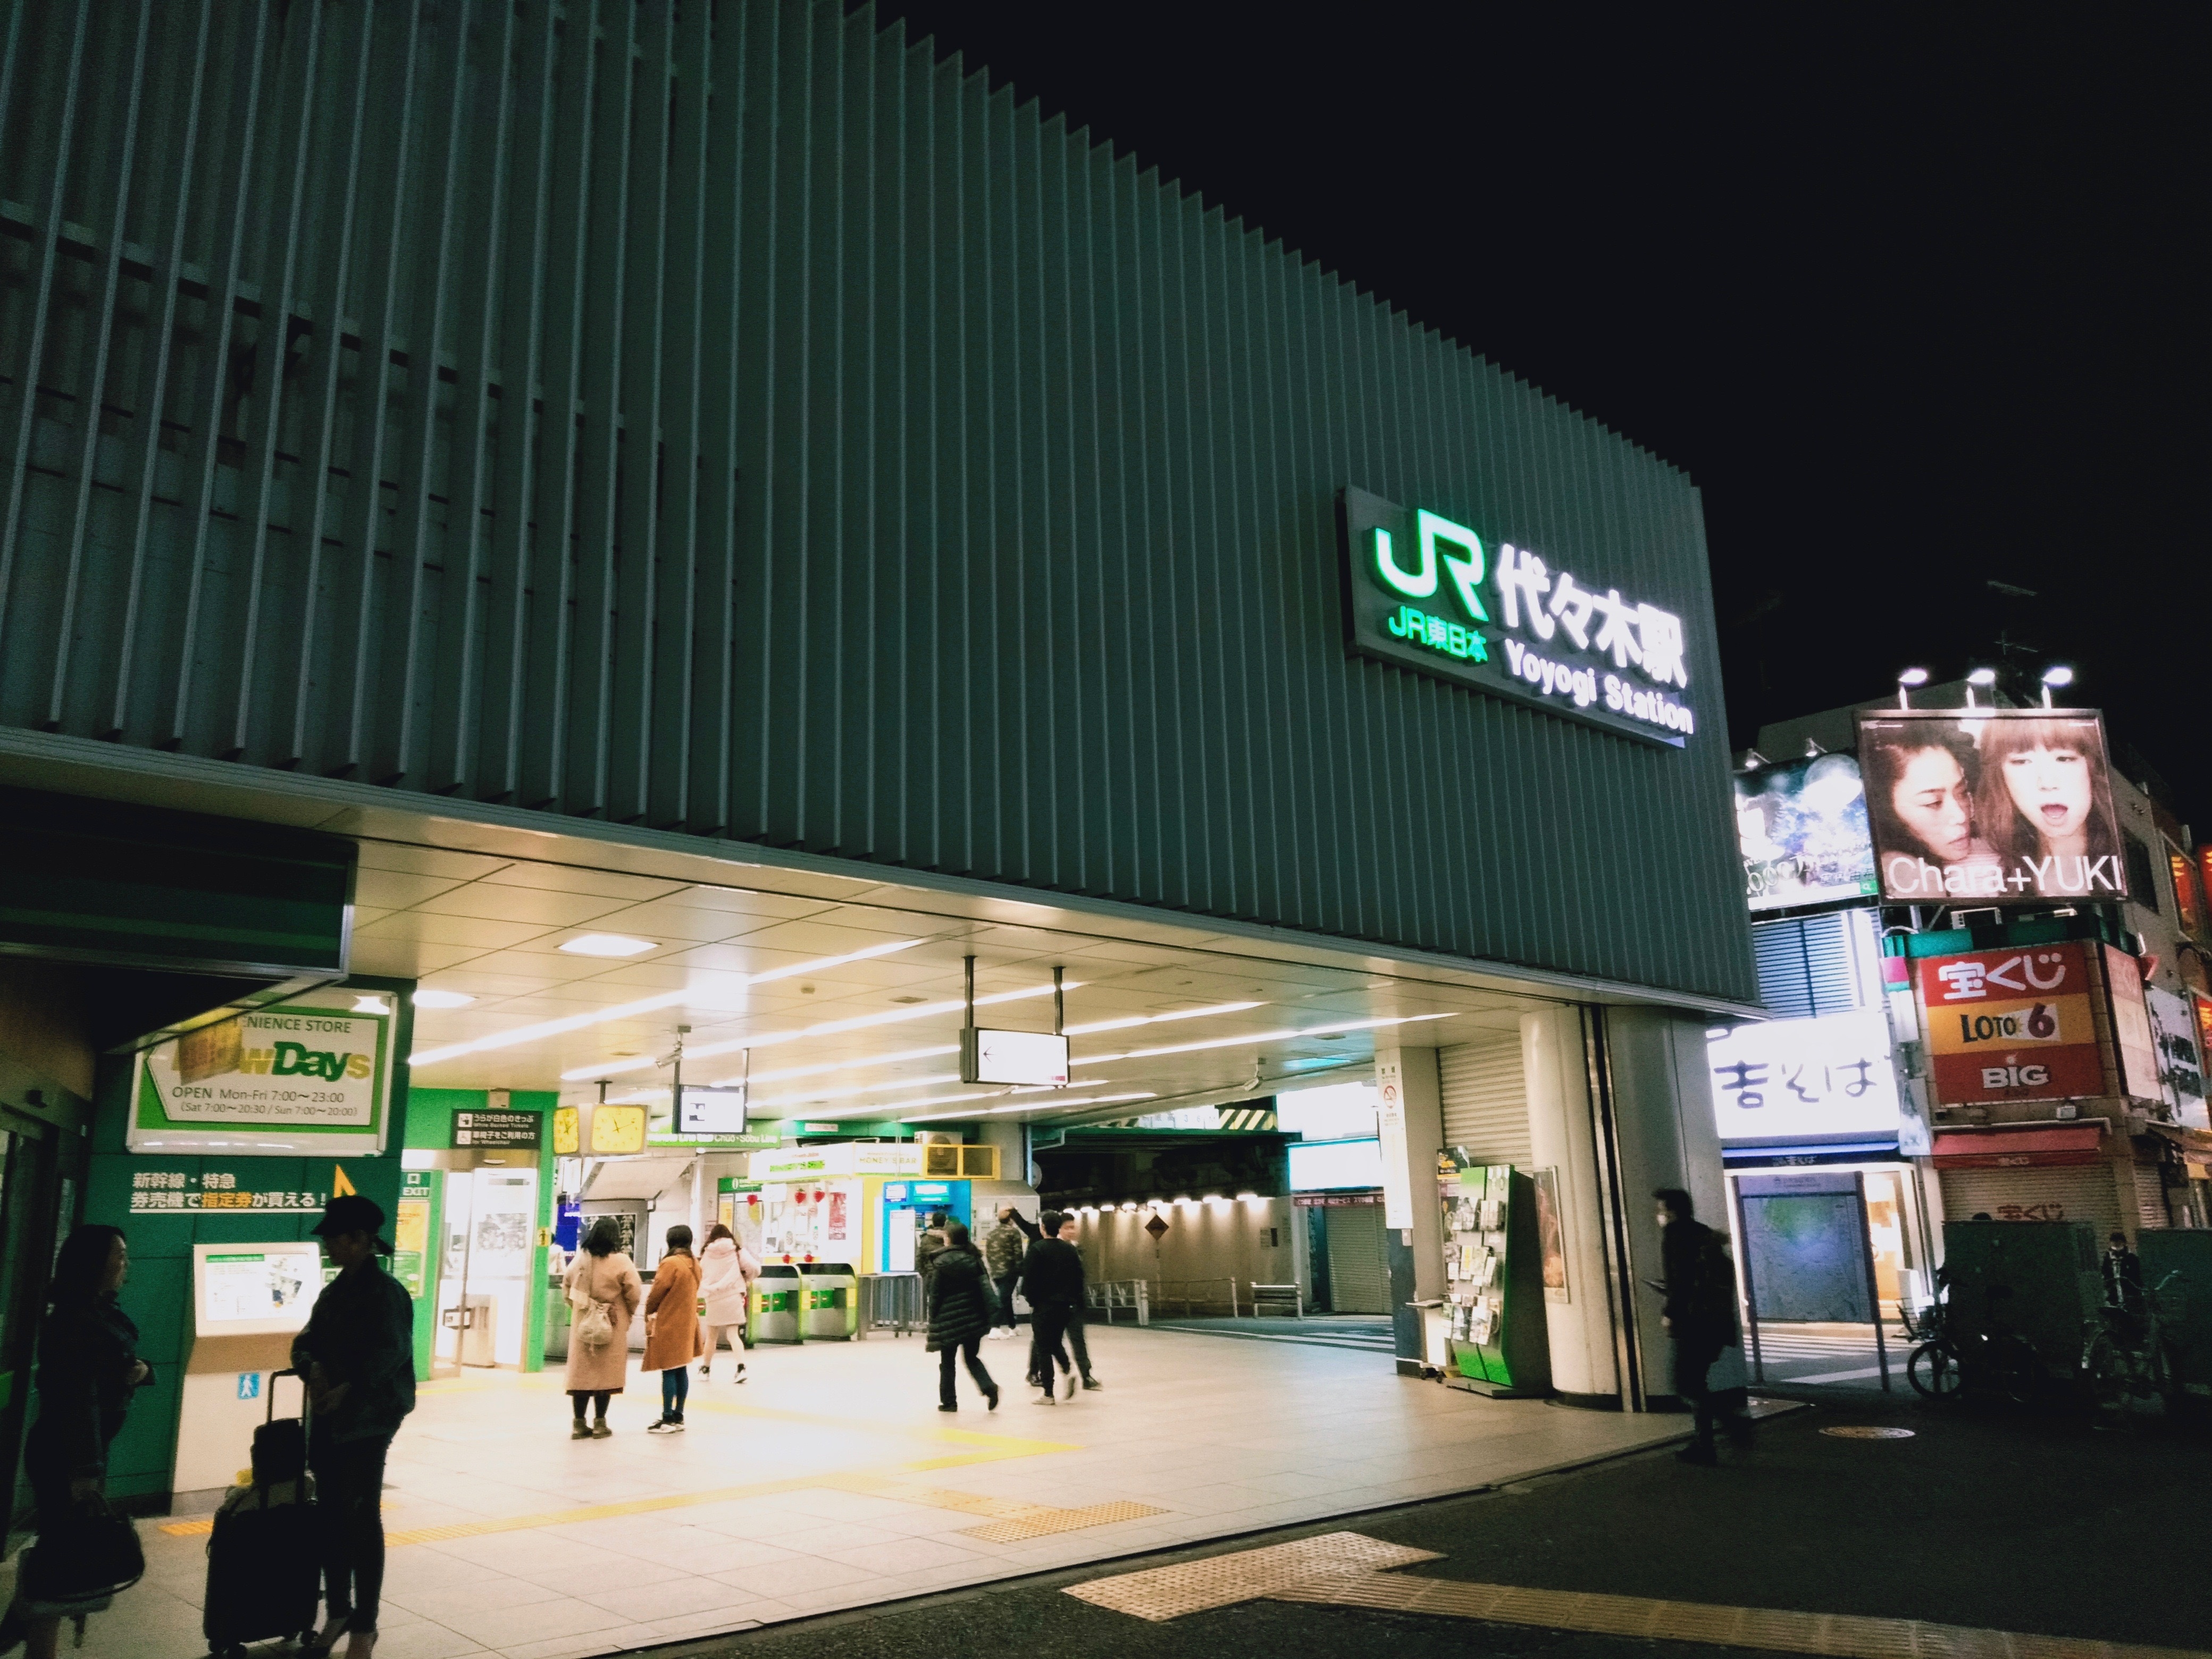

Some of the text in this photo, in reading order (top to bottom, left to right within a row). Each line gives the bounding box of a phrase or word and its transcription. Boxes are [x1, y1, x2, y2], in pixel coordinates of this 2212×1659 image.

[1375, 508, 1489, 622] JR
[1388, 605, 1488, 662] JR東日本
[1496, 543, 1688, 689] 代々木駅
[1504, 638, 1694, 734] Yoyogi Station
[1938, 952, 2066, 999] 宝くじ
[305, 1019, 351, 1033] STORE
[1960, 1001, 2056, 1043] LOTO 6
[172, 1086, 212, 1098] OPEN
[219, 1088, 267, 1101] Mon-Fri
[1981, 1065, 2049, 1088] BIG
[132, 1172, 236, 1189] 新幹線・特急
[403, 1187, 430, 1196] EXIT
